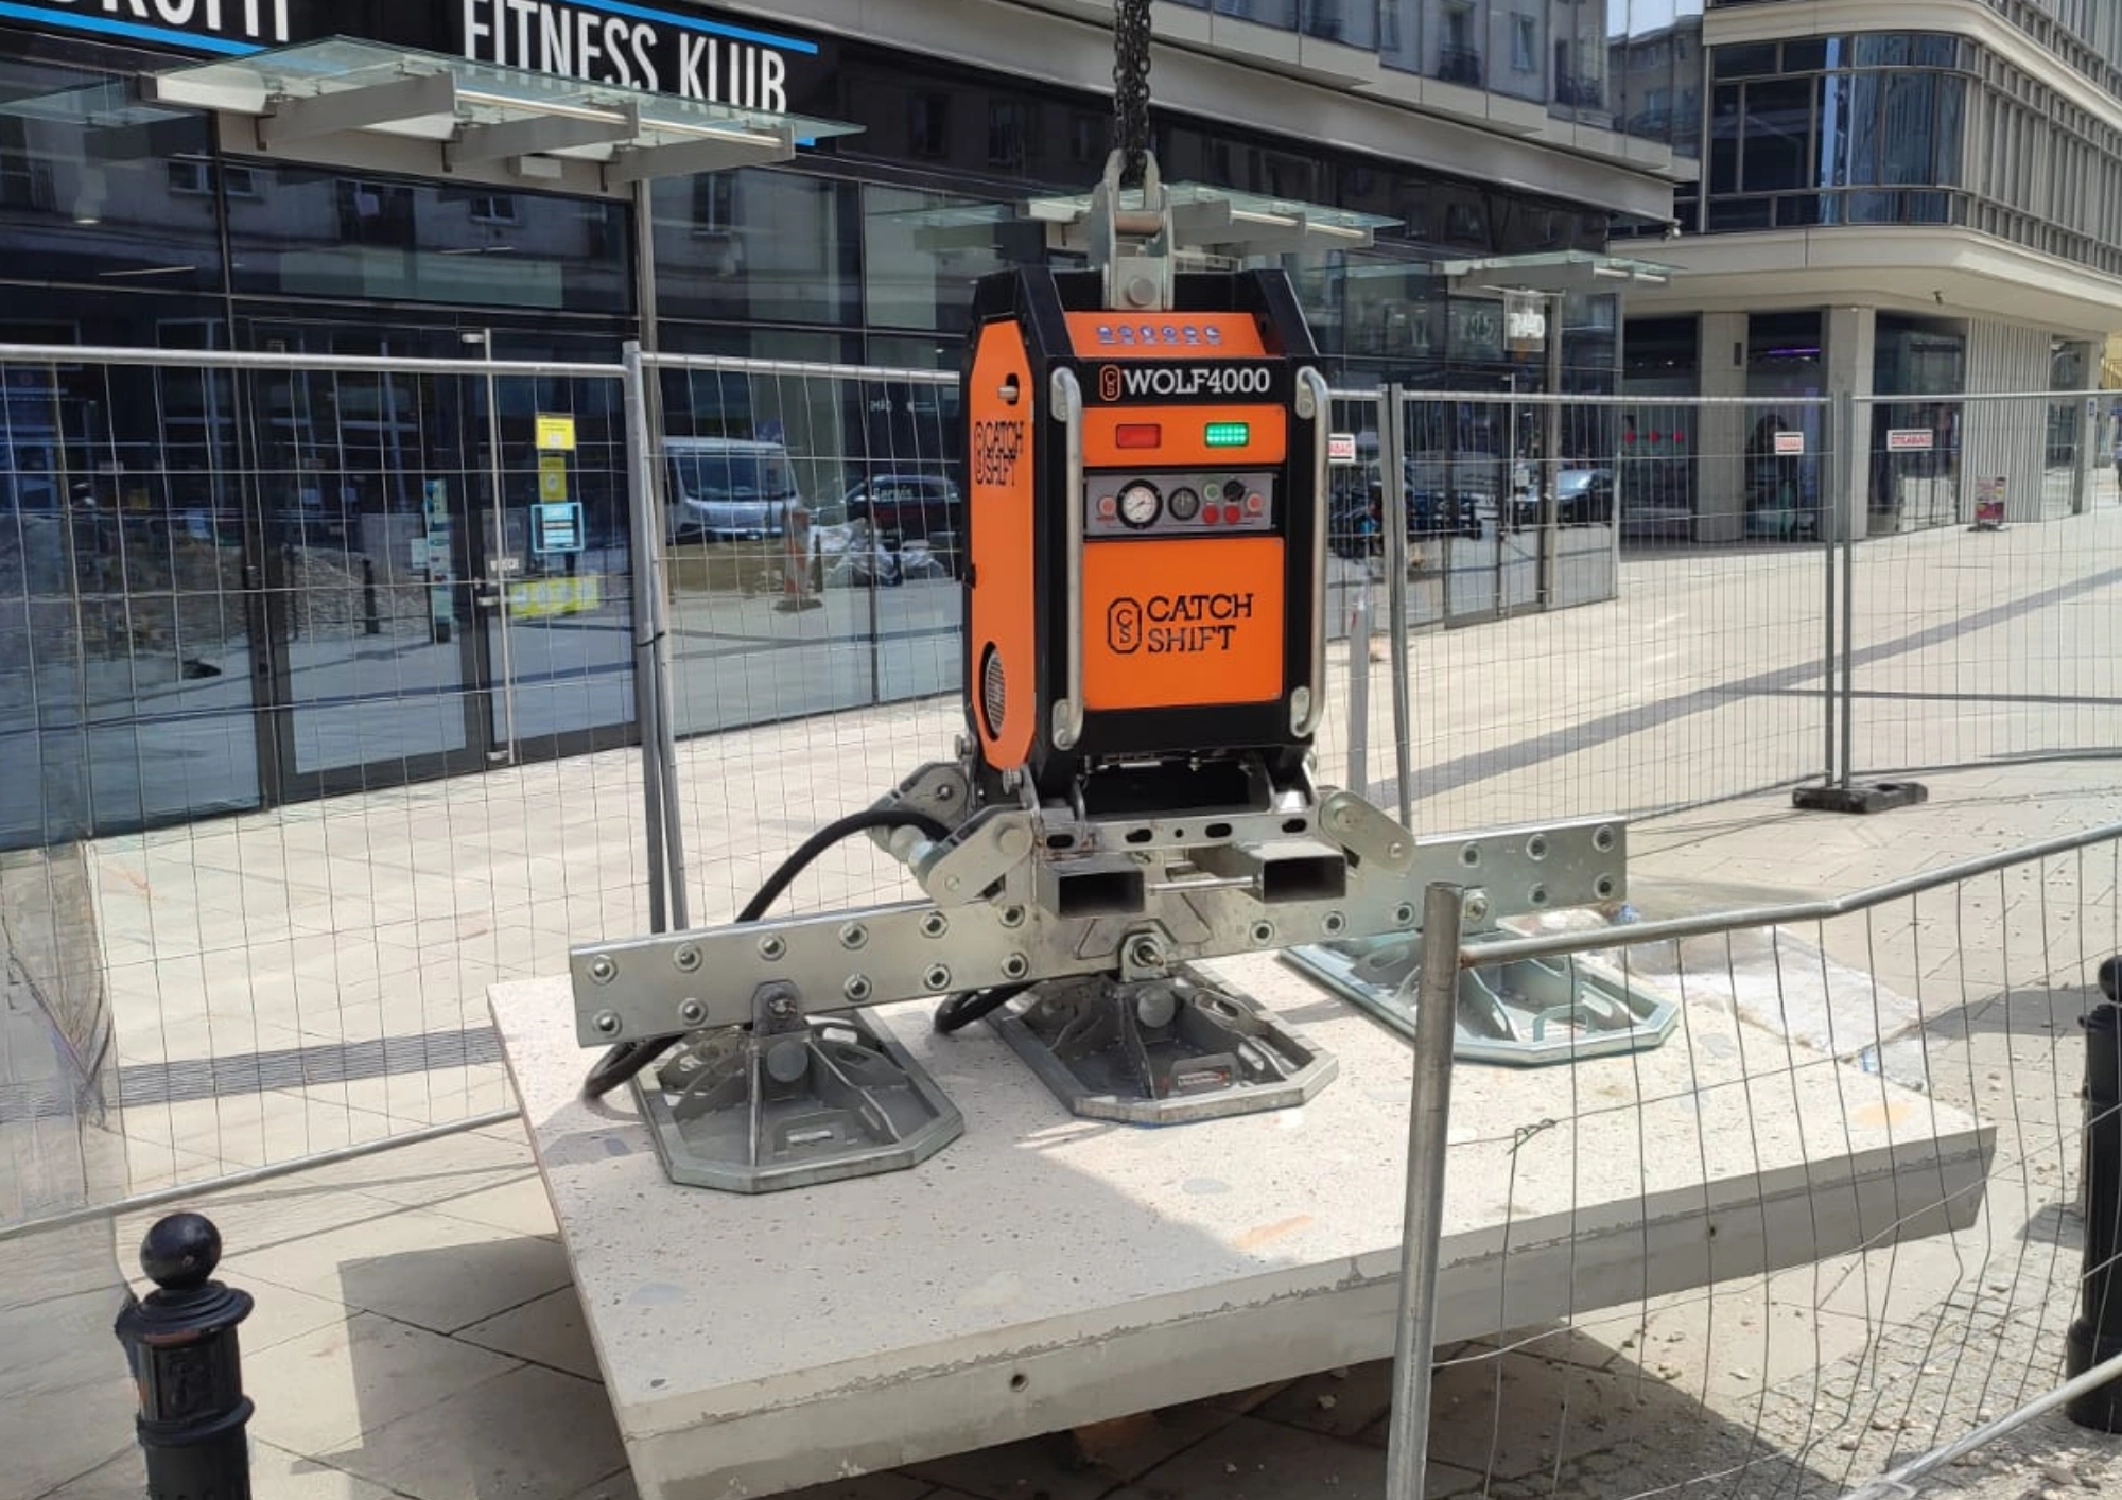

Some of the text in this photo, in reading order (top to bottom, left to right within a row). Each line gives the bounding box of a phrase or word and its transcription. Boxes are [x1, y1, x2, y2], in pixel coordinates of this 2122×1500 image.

[464, 0, 787, 113] FITNESS KLUB
[1123, 367, 1271, 396] WOLF4000
[1146, 593, 1255, 623] CATCH
[1147, 624, 1237, 653] SHIFT
